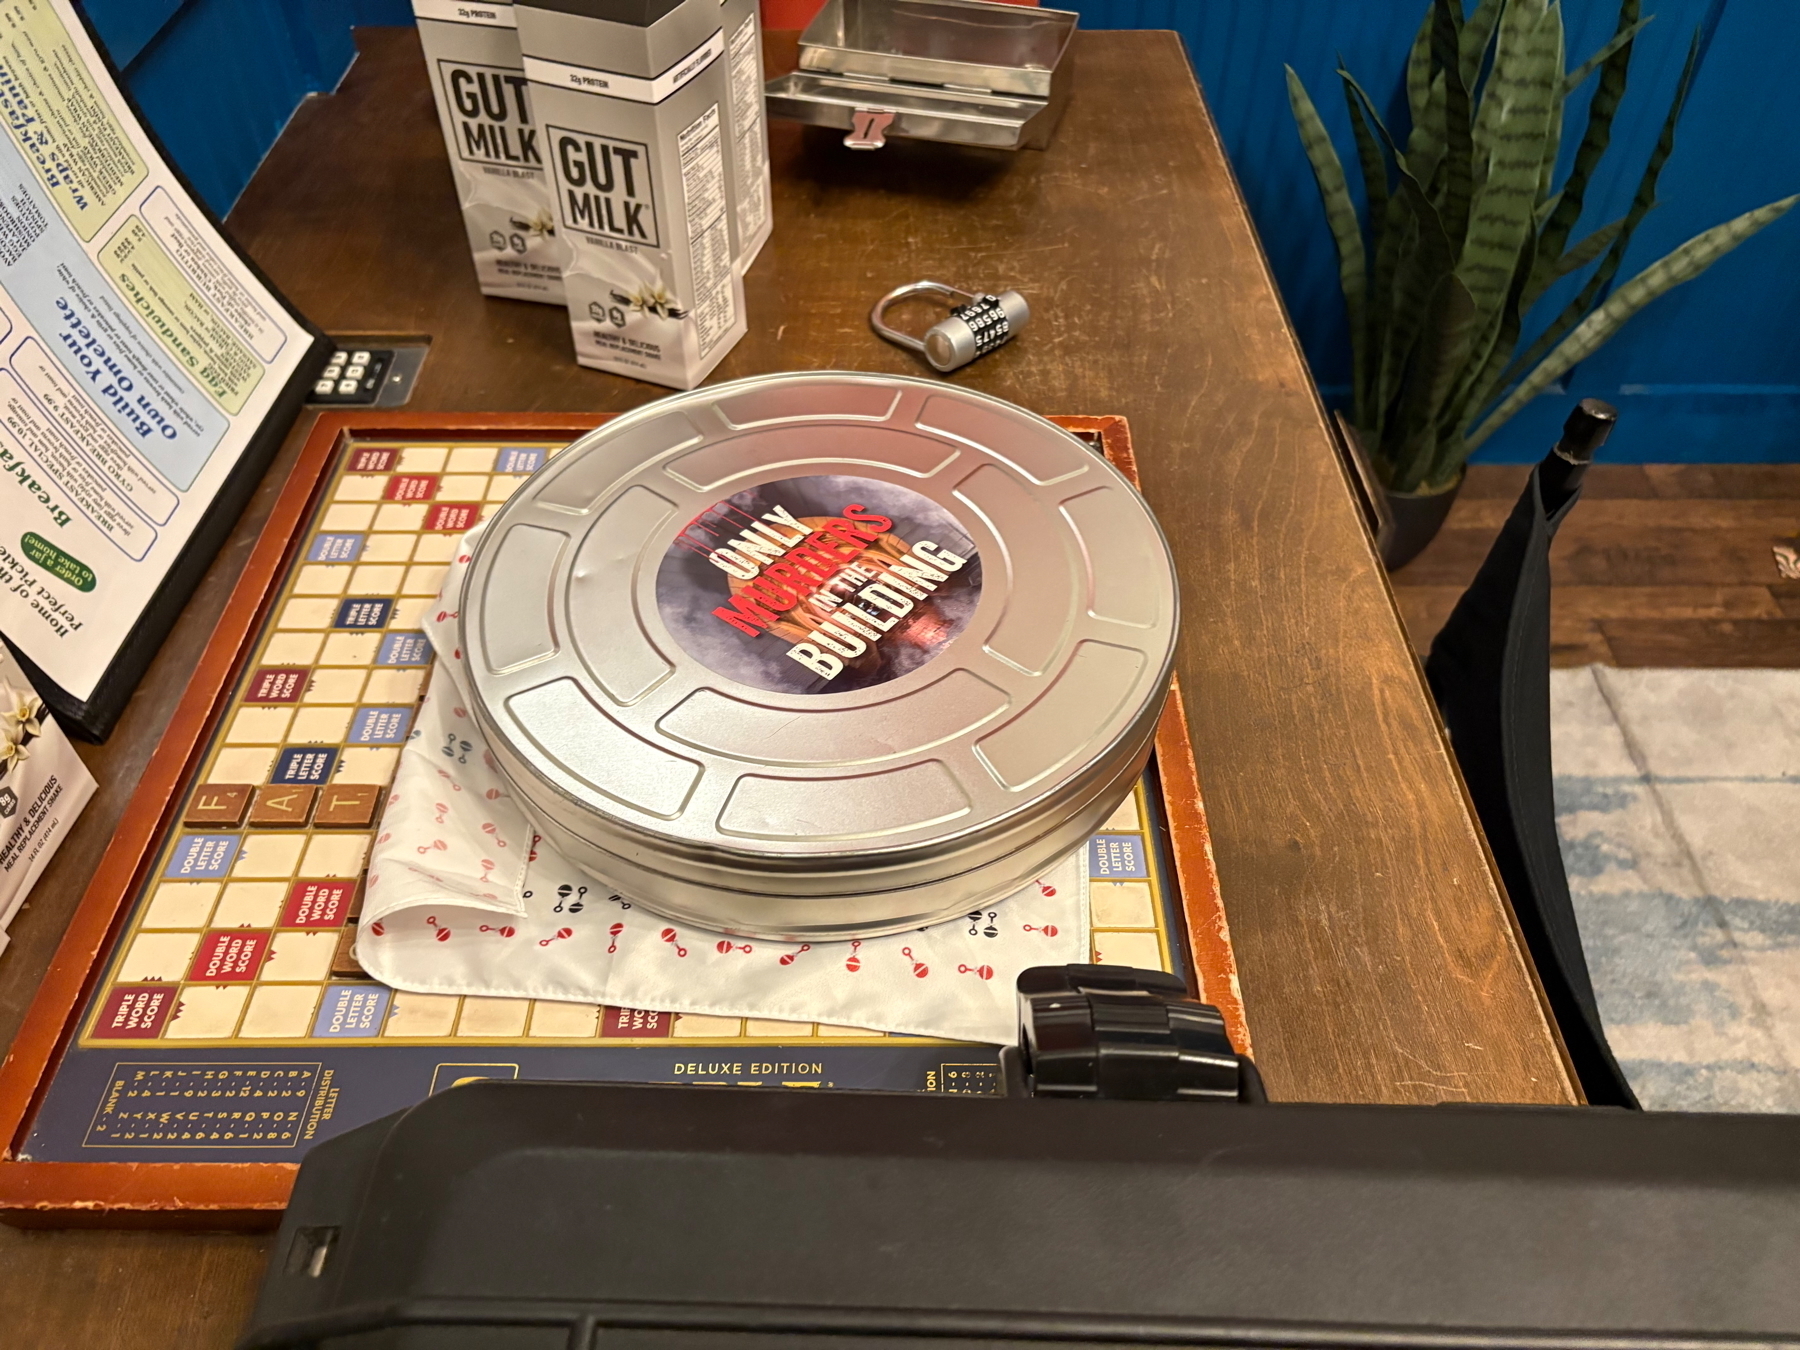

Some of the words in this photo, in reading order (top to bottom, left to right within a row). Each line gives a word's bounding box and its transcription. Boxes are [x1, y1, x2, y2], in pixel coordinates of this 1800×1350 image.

[471, 10, 496, 19] PROTEIN
[583, 77, 609, 88] PROTEIN
[452, 70, 528, 124] GUT
[34, 131, 49, 146] &
[462, 122, 542, 164] MILK
[62, 142, 80, 164] WRAP
[49, 151, 88, 211] Wraps
[483, 167, 510, 177] VANILLA
[512, 171, 534, 179] BLAST
[559, 137, 638, 198] GUT
[78, 164, 106, 207] AMERICAN
[11, 196, 40, 238] POTATOES
[18, 184, 48, 227] TOMATOES
[568, 189, 648, 240] MILK
[16, 216, 35, 242] ONION
[586, 237, 613, 248] VANILLA
[616, 242, 638, 254] BLAST
[119, 273, 199, 368] Sandwiches
[56, 296, 134, 392] Omelette
[59, 332, 102, 384] Your
[200, 367, 228, 398] Egg
[43, 394, 59, 412] 9.99
[101, 384, 153, 438] Build
[7, 416, 27, 439] 10.99
[137, 395, 177, 440] Own
[61, 412, 107, 466] BREAKFAST
[29, 441, 64, 480] SPECIAL
[356, 452, 370, 470] TRIPLE
[367, 452, 380, 470] WORD
[377, 452, 390, 470] SCORE
[506, 451, 518, 472] DOUBLE
[517, 453, 528, 471] LETTER
[526, 453, 538, 470] SCORE
[108, 464, 133, 492] GYRO
[396, 478, 409, 500] DOUBLE
[406, 480, 418, 498] WORD
[417, 480, 429, 498] SCORE
[63, 480, 114, 532] BREAKFAST
[435, 507, 449, 530] DOUBLE
[447, 509, 459, 528] WORD
[457, 509, 469, 528] SCORE
[116, 522, 131, 536] three
[709, 505, 813, 580] ONLY
[25, 535, 57, 559] home!
[30, 550, 48, 563] jar
[319, 537, 334, 560] DOUBLE
[330, 539, 344, 558] LETTER
[342, 539, 355, 558] SCORE
[55, 565, 82, 586] Order
[58, 555, 80, 574] take
[82, 570, 93, 582] to
[711, 504, 892, 637] MURDERS
[10, 584, 29, 598] of
[809, 588, 843, 612] IN
[829, 562, 877, 592] THE
[31, 599, 69, 638] Home
[37, 586, 83, 631] Perfect
[345, 604, 361, 624] TRIPLE
[357, 604, 372, 625] LETTER
[369, 603, 384, 625] SCORE
[786, 540, 967, 681] BUILDING
[388, 636, 404, 663] DOUBLE
[400, 639, 414, 661] LETTER
[412, 639, 426, 661] SCORE
[258, 674, 275, 698] TRIPLE
[270, 674, 286, 698] WORD
[282, 674, 298, 698] SCORE
[361, 711, 378, 741] DOUBLE
[374, 714, 389, 738] LETTER
[386, 714, 401, 738] SCORE
[285, 754, 302, 779] TRIPLE
[298, 754, 315, 779] LETTER
[311, 754, 327, 779] SCORE
[197, 796, 227, 809] F
[266, 795, 298, 811] A
[329, 796, 360, 811] T
[0, 824, 25, 864] HEALTHY
[23, 816, 30, 826] &
[28, 775, 58, 818] DELICIOUS
[4, 852, 19, 872] MEAL
[17, 806, 49, 853] REPLACEMENT
[48, 784, 63, 808] SHAKE
[28, 853, 35, 862] 14
[38, 838, 44, 848] OZ
[43, 828, 52, 842] (414
[181, 838, 204, 873] DOUBLE
[195, 841, 216, 870] LETTER
[209, 841, 229, 870] SCORE
[1095, 838, 1110, 874] DOUBLE
[1110, 842, 1122, 871] LETTER
[1126, 842, 1135, 871] SCORE
[296, 886, 318, 923] DOUBLE
[310, 889, 329, 921] WORD
[324, 889, 343, 920] SCORE
[206, 936, 230, 976] DOUBLE
[221, 939, 242, 973] WORD
[236, 939, 256, 972] SCORE
[112, 994, 136, 1028] TRIPLE
[126, 993, 149, 1029] WORD
[141, 993, 164, 1028] SCORE
[330, 990, 352, 1032] DOUBLE
[346, 994, 365, 1028] LETTER
[360, 994, 379, 1028] SCORE
[674, 1063, 742, 1074] DELUXE
[751, 1063, 822, 1074] EDITION
[104, 1080, 124, 1114] BLANK
[304, 1070, 334, 1139] DISTRIBUTION
[322, 1088, 339, 1120] LETTER
